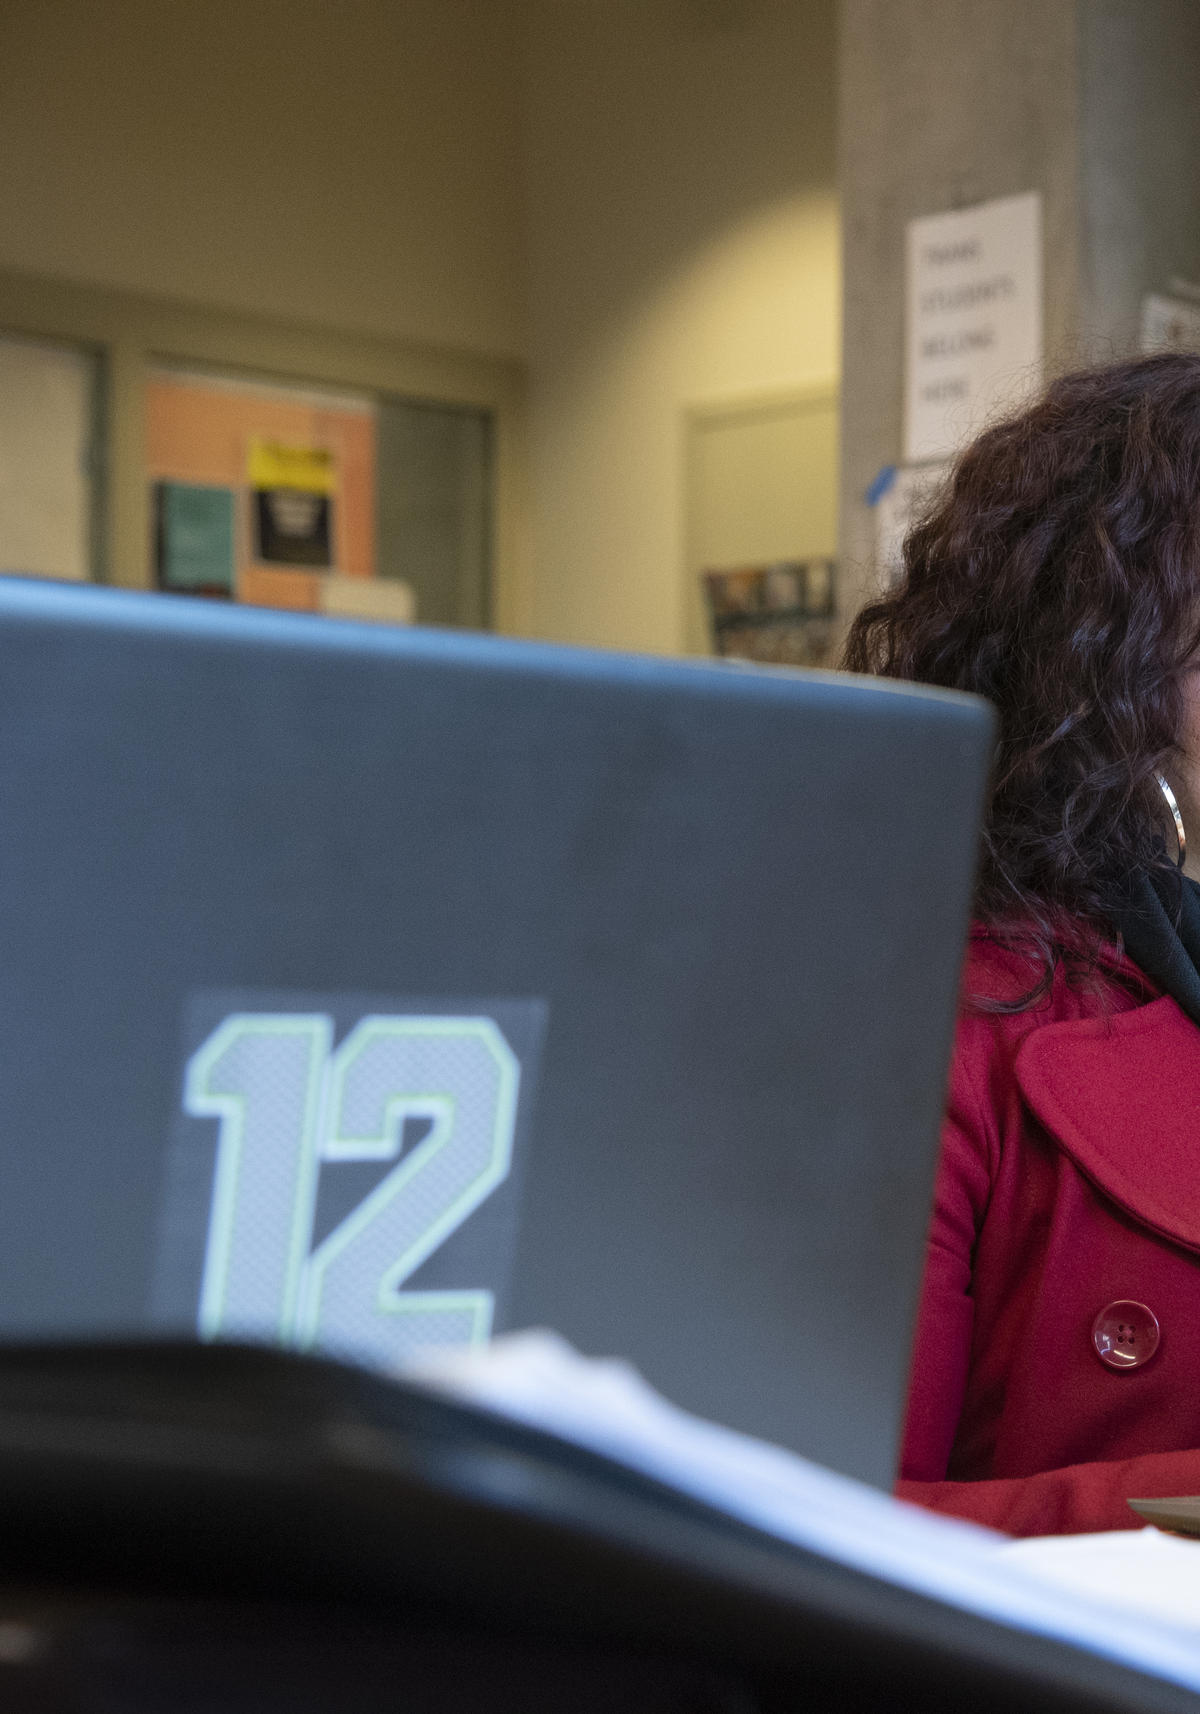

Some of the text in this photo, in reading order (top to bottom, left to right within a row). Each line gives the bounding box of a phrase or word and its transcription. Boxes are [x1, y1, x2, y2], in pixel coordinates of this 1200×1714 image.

[921, 275, 1016, 312] STUDENTS
[921, 329, 995, 357] BELONG
[183, 1011, 521, 1362] 12
